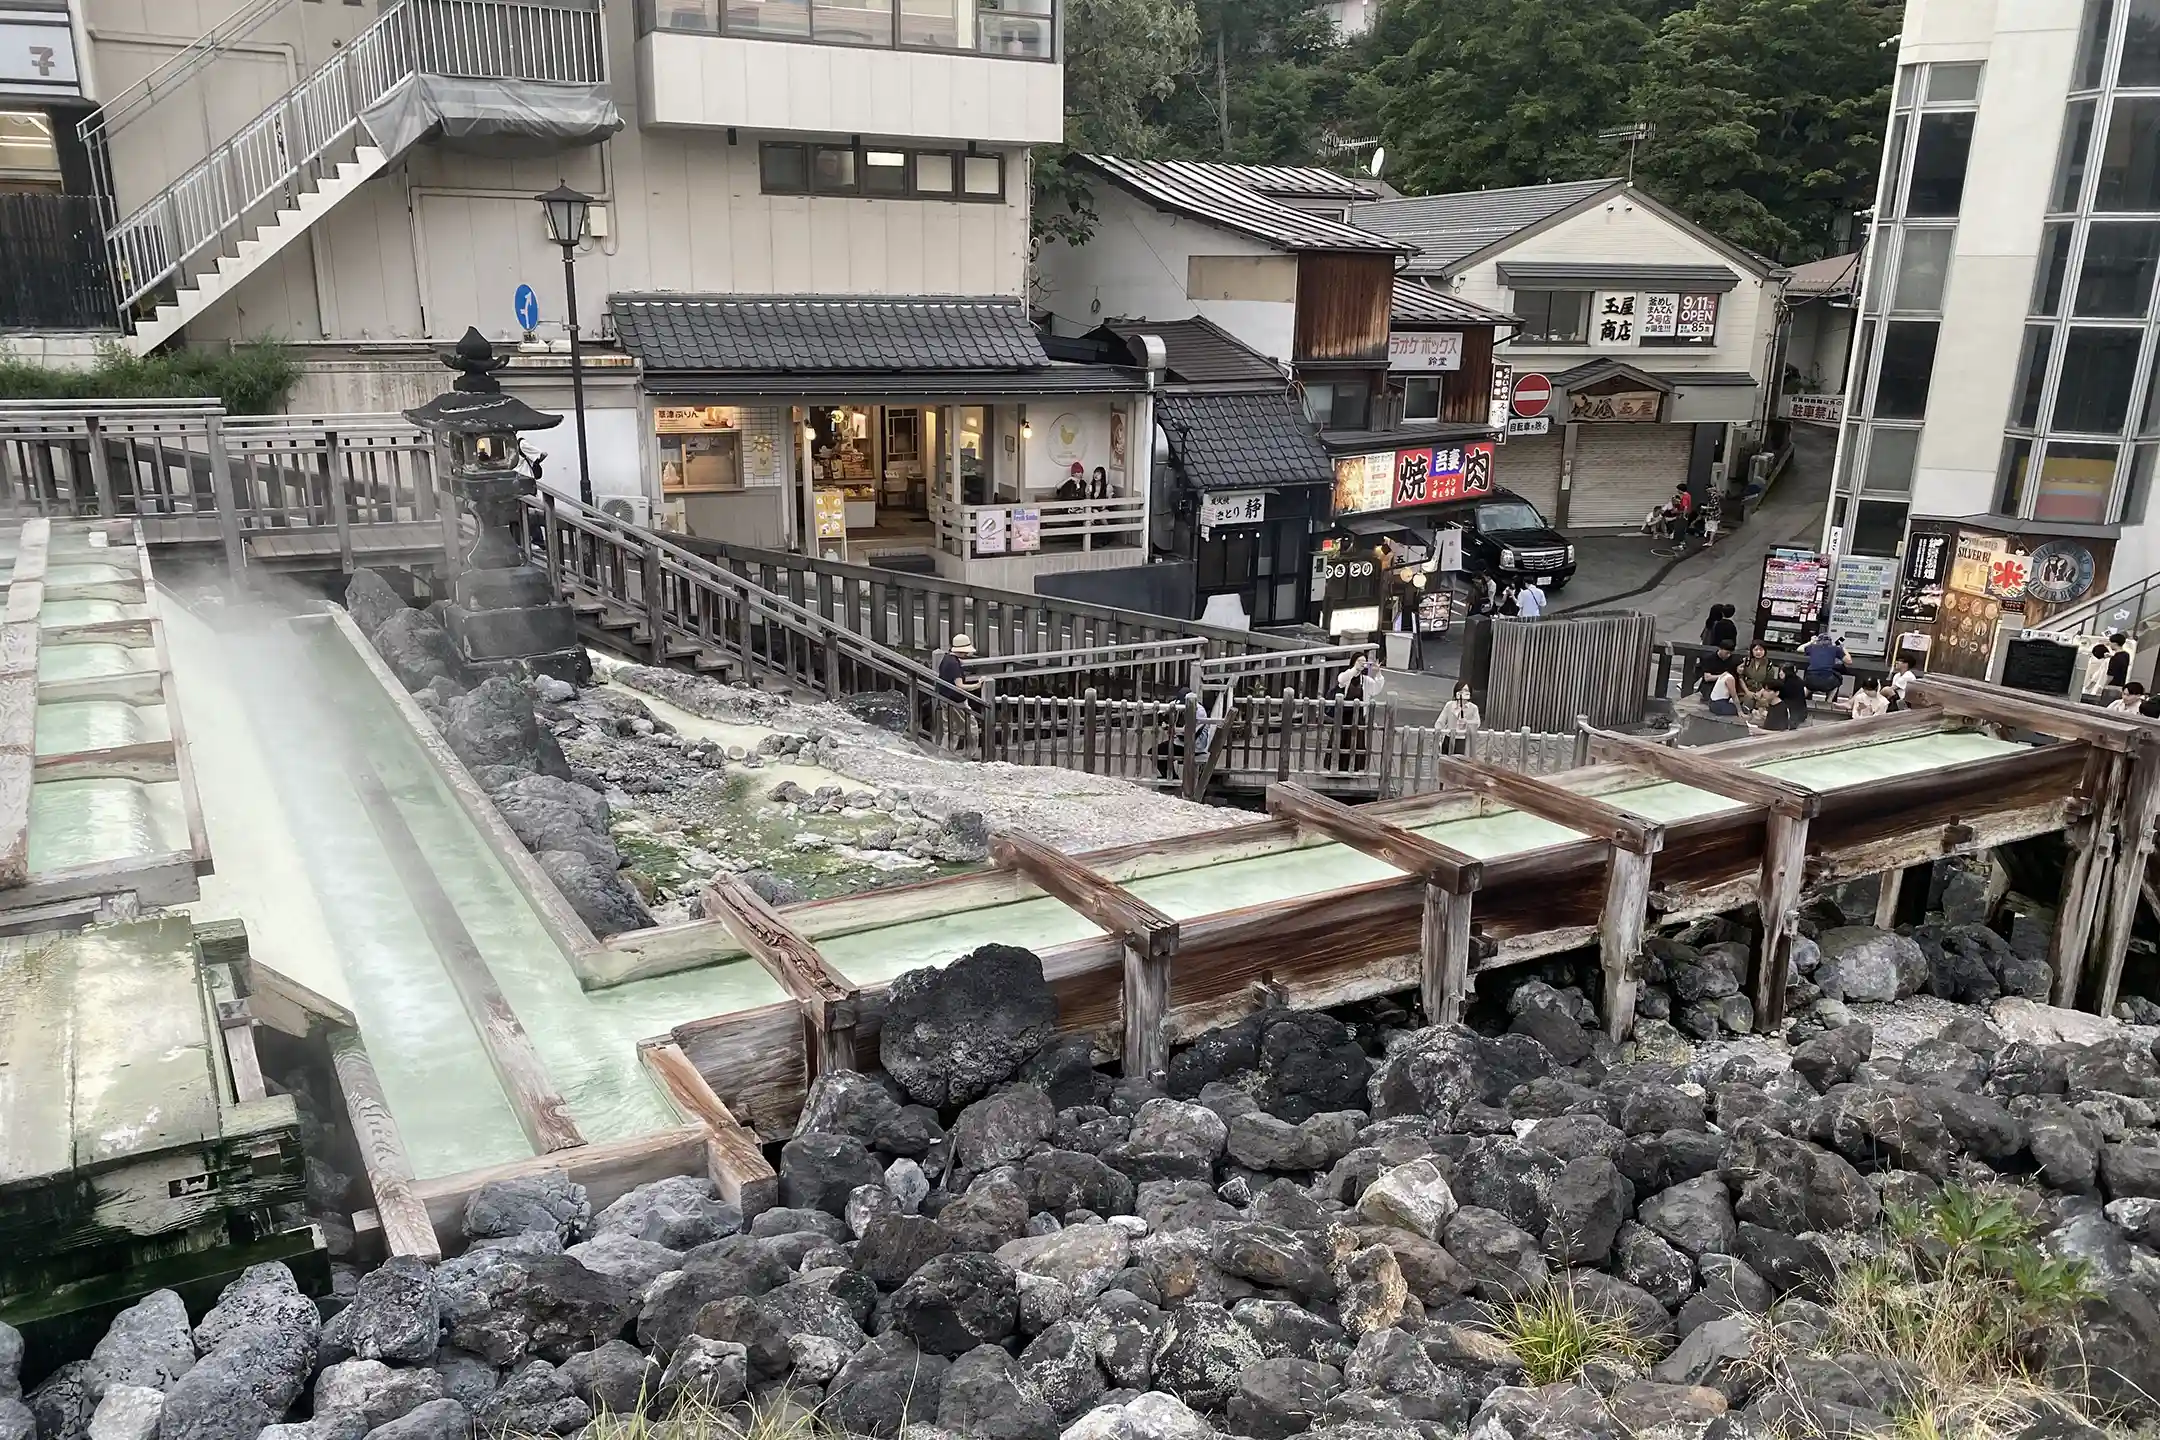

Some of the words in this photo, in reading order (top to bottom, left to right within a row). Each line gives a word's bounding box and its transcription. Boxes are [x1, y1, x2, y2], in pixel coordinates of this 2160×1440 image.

[1601, 296, 1635, 315] 玉屋
[1648, 297, 1672, 306] 釜めし
[1683, 296, 1708, 311] 9/11
[1647, 306, 1672, 314] まんてん
[1681, 311, 1713, 321] OPEN
[1646, 315, 1672, 324] 2号店
[1600, 319, 1632, 341] 商店
[1421, 336, 1457, 354] ボックス
[1791, 404, 1838, 420] 駐車禁止
[1510, 421, 1547, 432] 自転車を除く
[1435, 448, 1460, 472] 吾妻
[1396, 453, 1428, 503] 焼
[1462, 447, 1491, 492] 肉
[1957, 546, 1981, 561] SILVER
